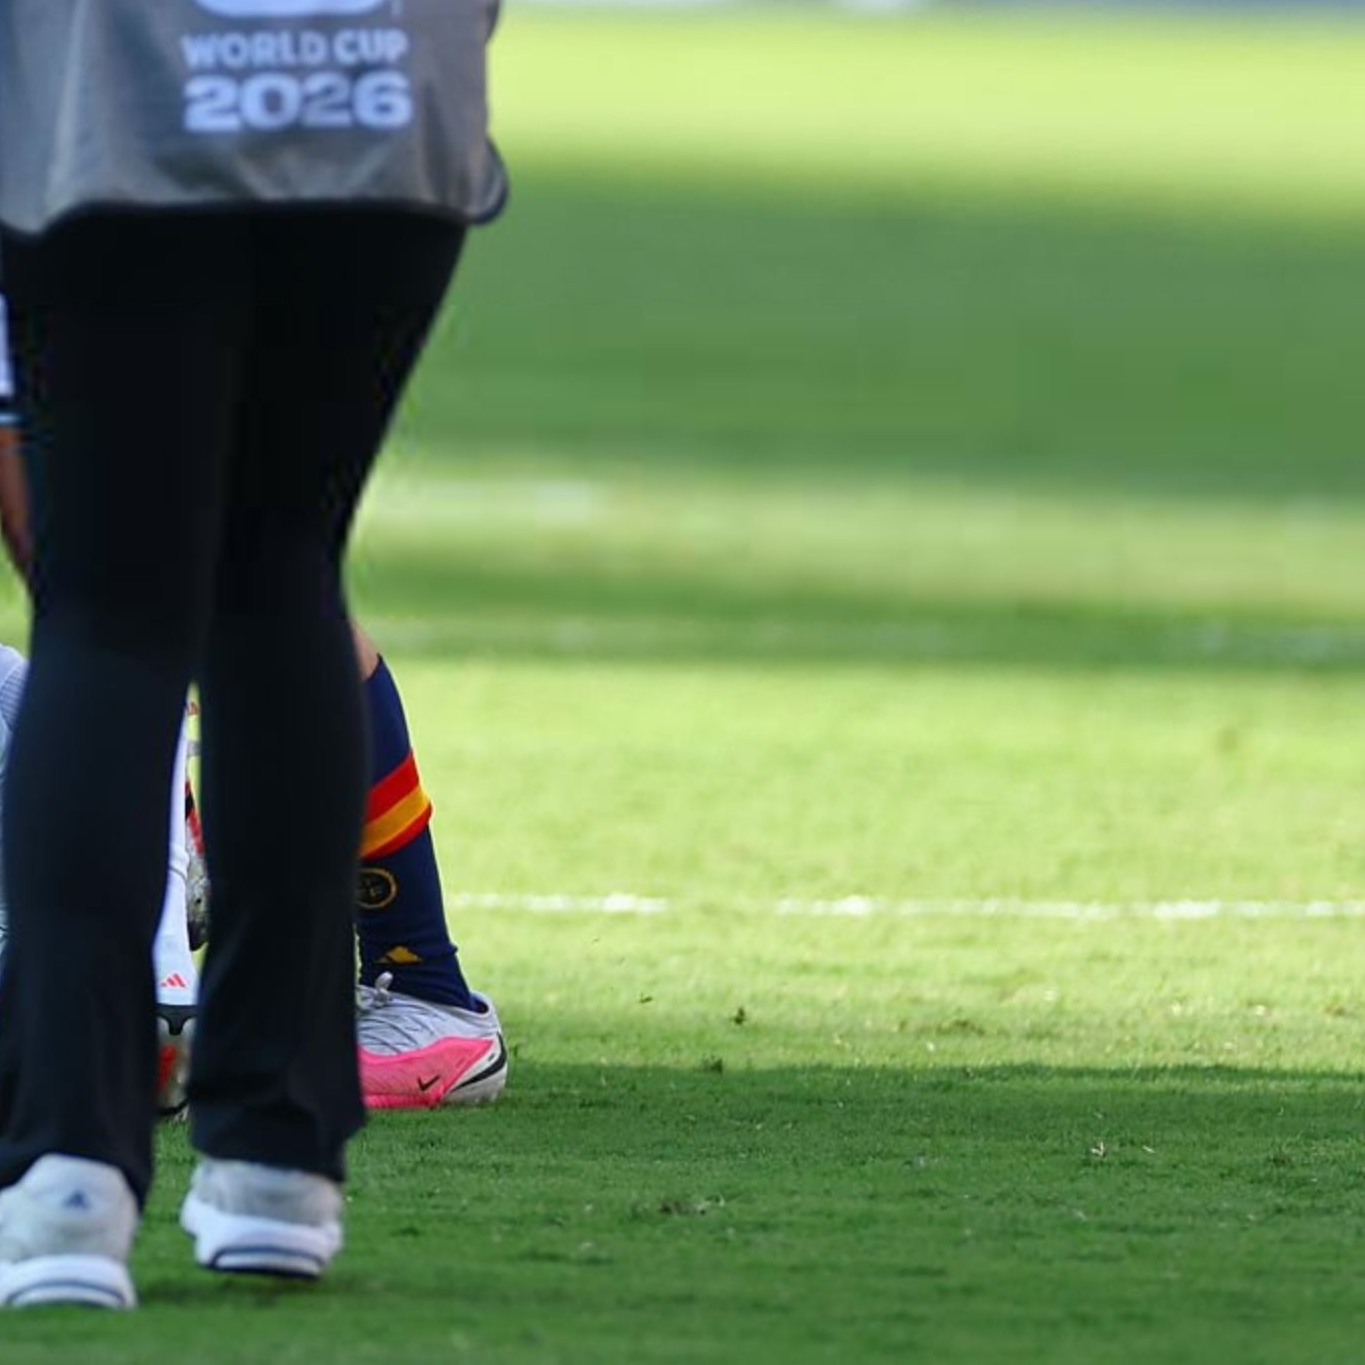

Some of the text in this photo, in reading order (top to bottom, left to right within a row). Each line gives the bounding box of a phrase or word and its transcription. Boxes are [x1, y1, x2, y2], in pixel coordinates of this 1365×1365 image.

[181, 26, 411, 71] WORLD CUP
[182, 70, 413, 132] 2026
